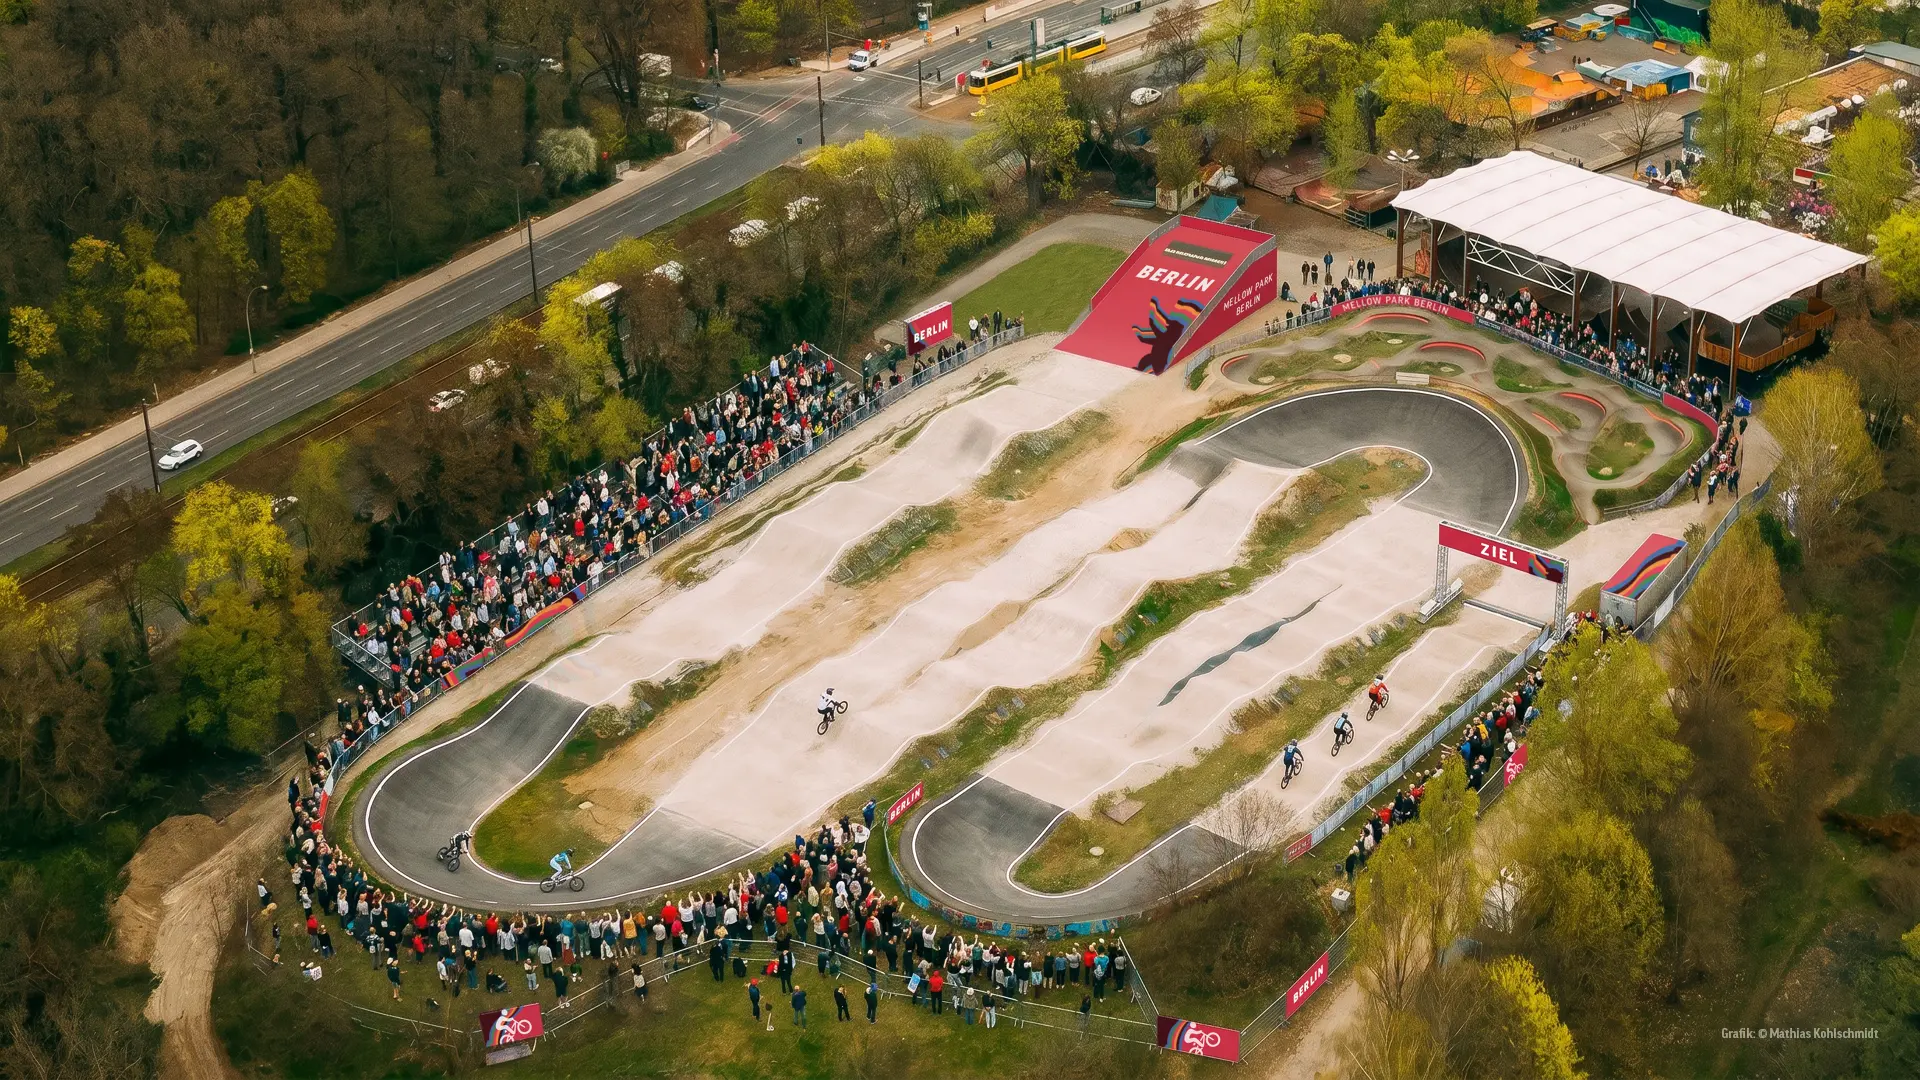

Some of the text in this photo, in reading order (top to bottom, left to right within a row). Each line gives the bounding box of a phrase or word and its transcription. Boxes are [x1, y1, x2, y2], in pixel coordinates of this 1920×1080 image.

[1135, 265, 1215, 292] BERLIN
[1223, 272, 1273, 311] MELLOW PARK
[1236, 293, 1261, 316] BERLIN
[1342, 296, 1449, 315] MELLOW PARK BERLIN
[914, 319, 948, 344] BERLIN
[1480, 542, 1518, 564] ZIEL
[890, 787, 921, 821] BERLIN
[1293, 964, 1324, 1004] BERLIN
